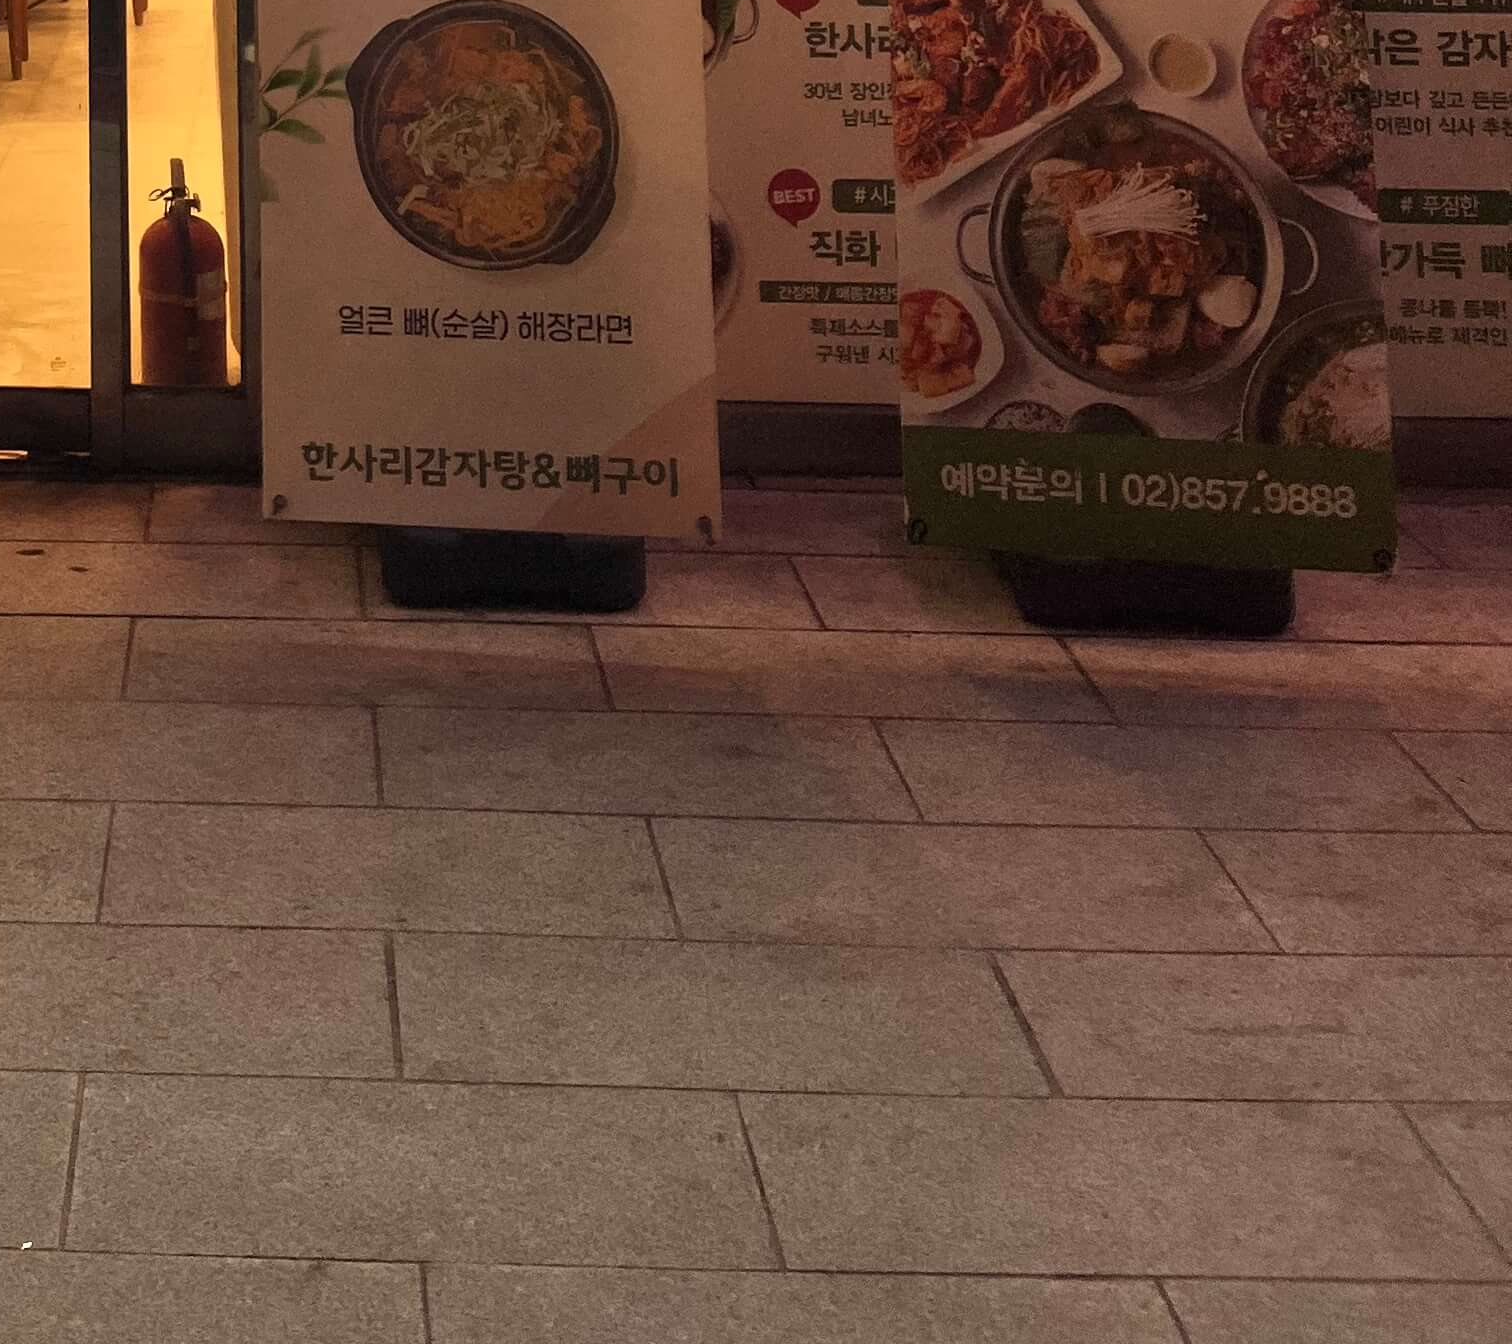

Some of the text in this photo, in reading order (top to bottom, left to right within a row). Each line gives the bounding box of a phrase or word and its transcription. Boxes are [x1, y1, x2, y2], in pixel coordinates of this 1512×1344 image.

[1437, 29, 1512, 68] 감자
[803, 82, 893, 101] 30년 장인
[1429, 90, 1465, 109] 깊고
[1472, 90, 1512, 110] 든든
[1376, 116, 1431, 136] 어린이
[1439, 116, 1475, 137] 식사
[772, 188, 816, 204] BEST
[1423, 195, 1481, 218] 푸짐한
[809, 230, 881, 268] 직화
[338, 305, 633, 345] 얼큰 뼈(순살) 해장라면
[302, 441, 680, 498] 한사리감자탕&뼈구이
[940, 459, 1358, 519] 예약문의 02)857.9888
